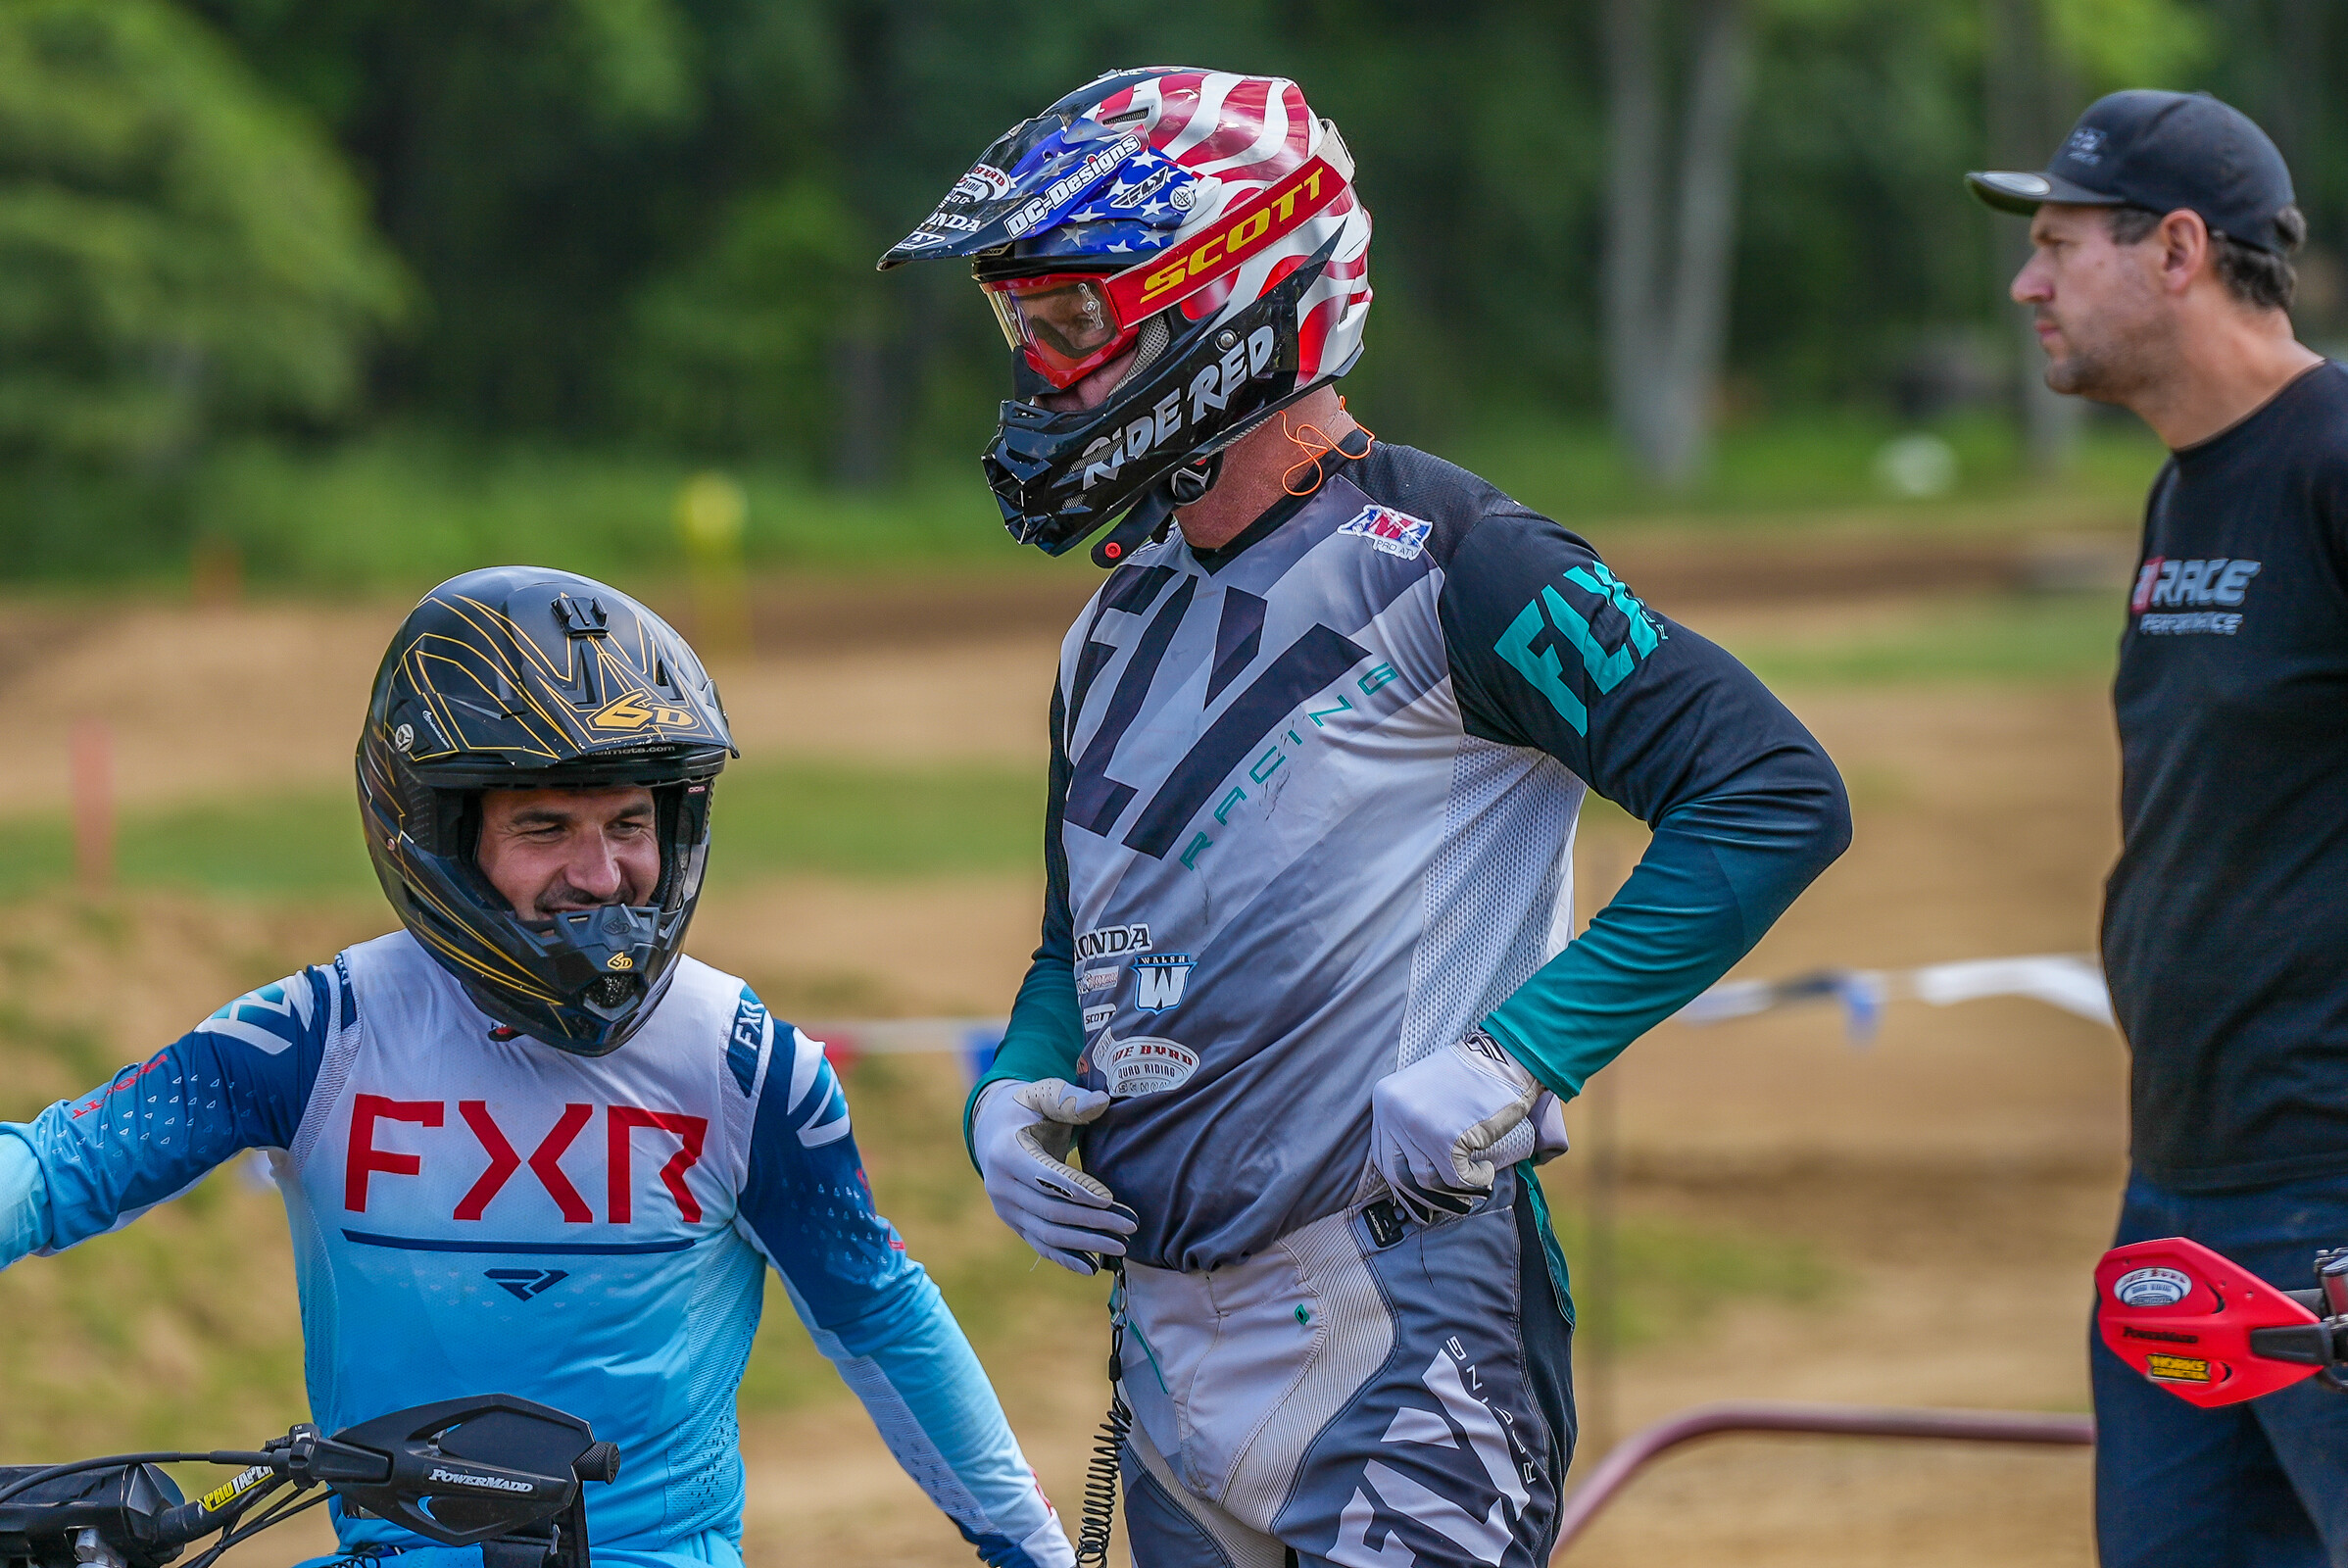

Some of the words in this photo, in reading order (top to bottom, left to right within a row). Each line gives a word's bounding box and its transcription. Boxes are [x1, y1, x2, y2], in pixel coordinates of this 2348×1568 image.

[1005, 133, 1142, 239] DC-Designs
[1140, 166, 1324, 305] SCOTT
[1082, 388, 1183, 491] RIDE
[1187, 324, 1275, 425] RED
[1376, 538, 1397, 553] PRO
[1398, 546, 1418, 560] ATV
[1493, 560, 1659, 738] FLY
[594, 692, 695, 727] 6D
[1179, 661, 1398, 872] RACING
[607, 951, 634, 971] 6D
[1140, 955, 1187, 965] WALSH
[734, 999, 765, 1051] FXR
[1085, 1009, 1116, 1025] SCOTT
[1118, 1065, 1141, 1079] QUAD
[1144, 1063, 1176, 1078] RIDING
[344, 1093, 709, 1225] FXR
